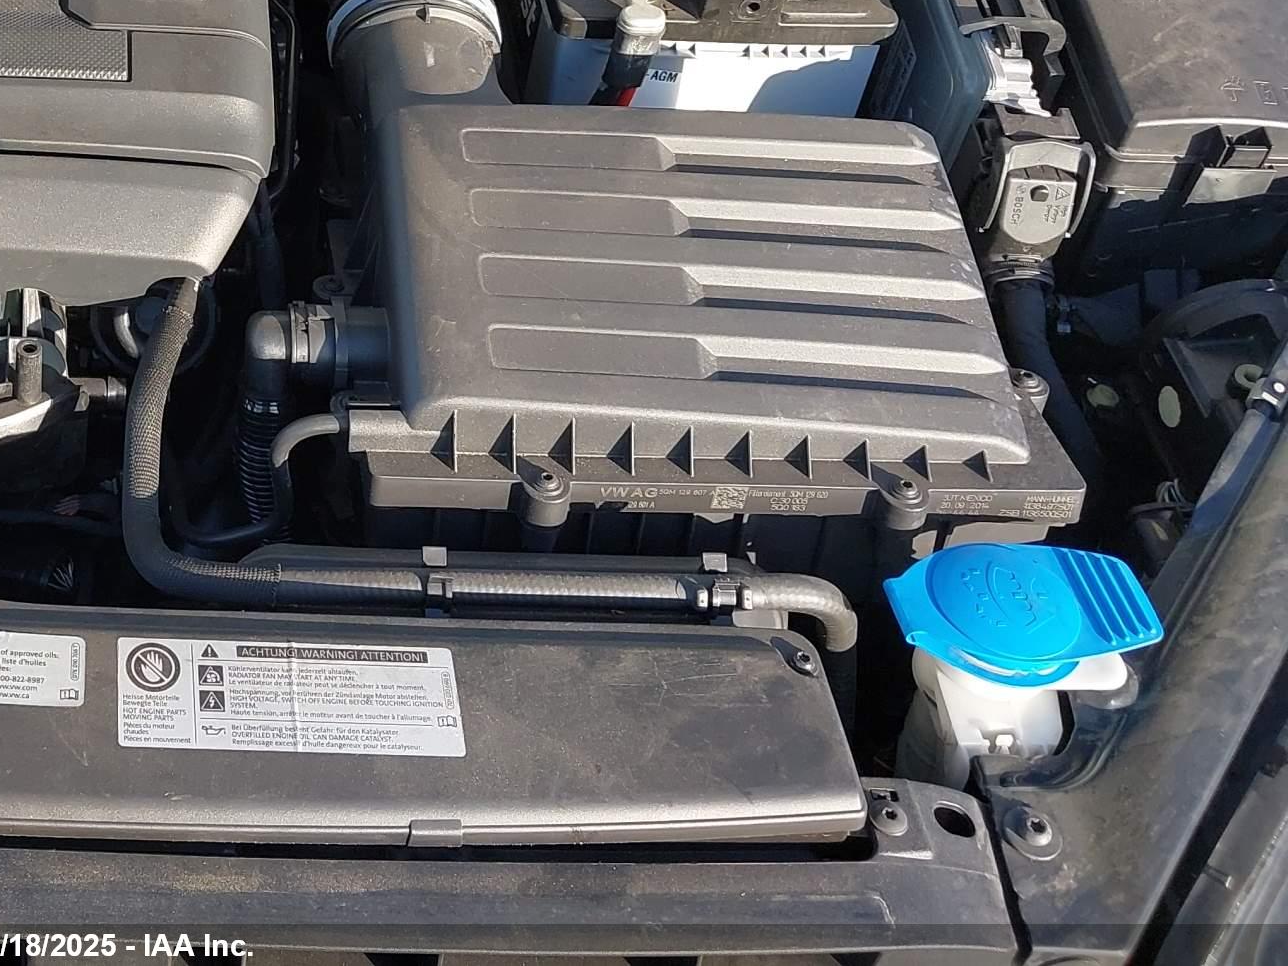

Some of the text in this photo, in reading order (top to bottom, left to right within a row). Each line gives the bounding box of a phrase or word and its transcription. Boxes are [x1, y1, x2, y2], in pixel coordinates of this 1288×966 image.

[1010, 196, 1024, 225] BOSCH
[601, 487, 629, 497] VW
[631, 488, 657, 497] AG
[10, 650, 43, 659] approved
[242, 647, 424, 662] ACHTUNG! WARNING! ATTENTION!
[232, 738, 273, 747] Remplissage
